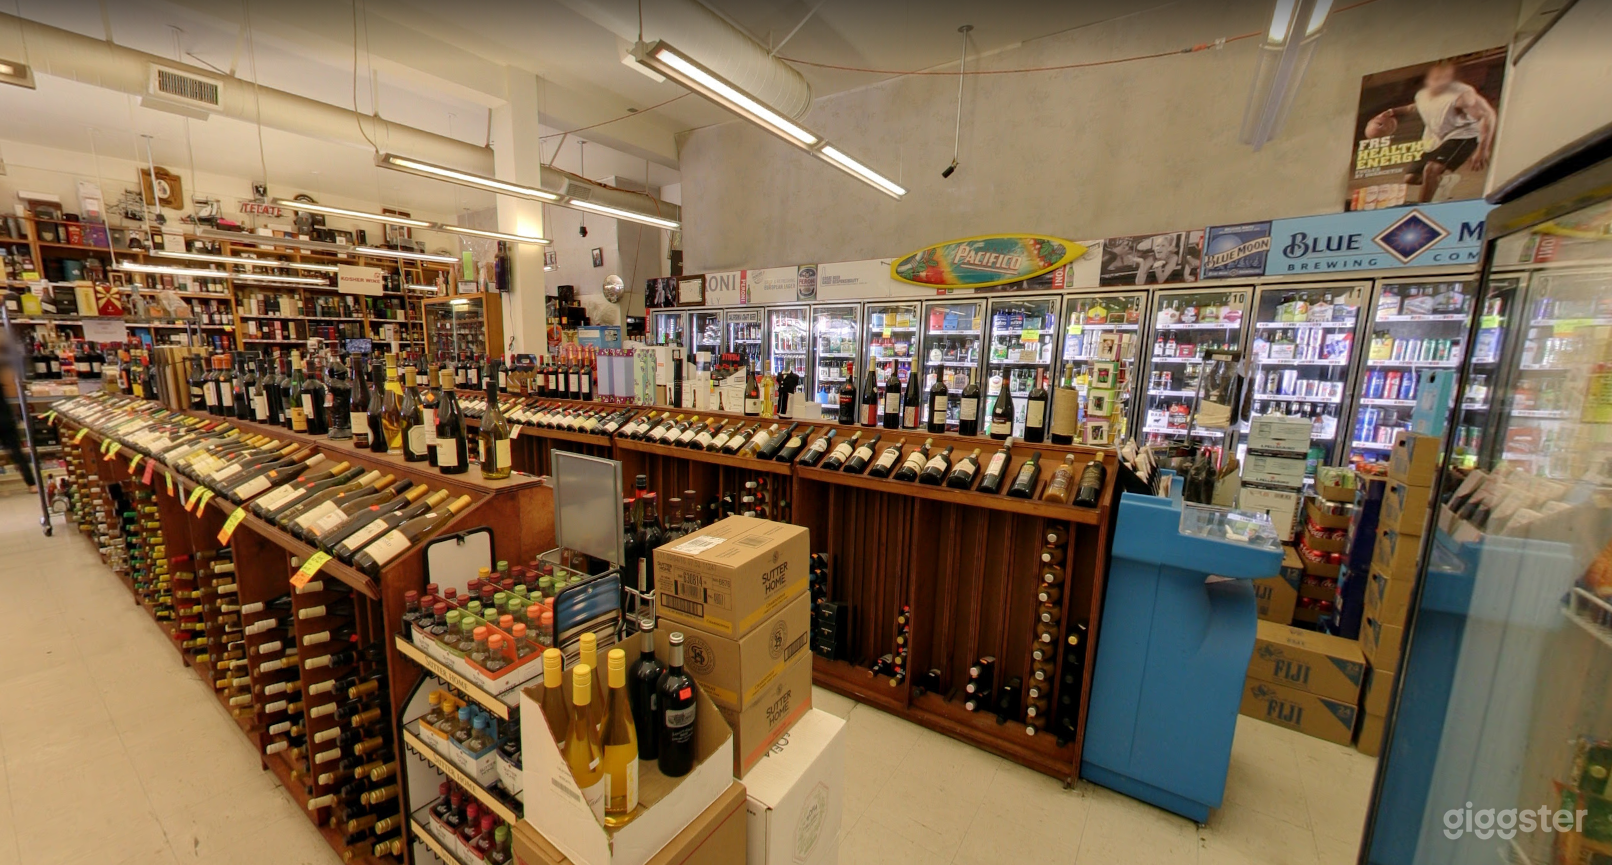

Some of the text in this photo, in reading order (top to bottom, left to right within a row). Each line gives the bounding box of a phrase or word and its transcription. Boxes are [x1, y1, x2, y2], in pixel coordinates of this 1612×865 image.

[1357, 138, 1436, 160] HEALTHY
[1359, 136, 1392, 151] FRS
[1356, 151, 1424, 170] ENERGY
[241, 202, 282, 216] TECATE
[953, 244, 1023, 270] PACIFICO
[1204, 238, 1270, 268] BLUE MOON
[1282, 231, 1362, 259] BLUE
[1287, 258, 1378, 272] BREWING
[1232, 293, 1245, 304] 10
[762, 561, 788, 585] SUTTER
[765, 573, 787, 595] HOME
[1273, 658, 1312, 684] FIJI
[766, 690, 792, 719] SUTTER
[768, 701, 790, 727] HOME
[1266, 698, 1304, 726] FIJI
